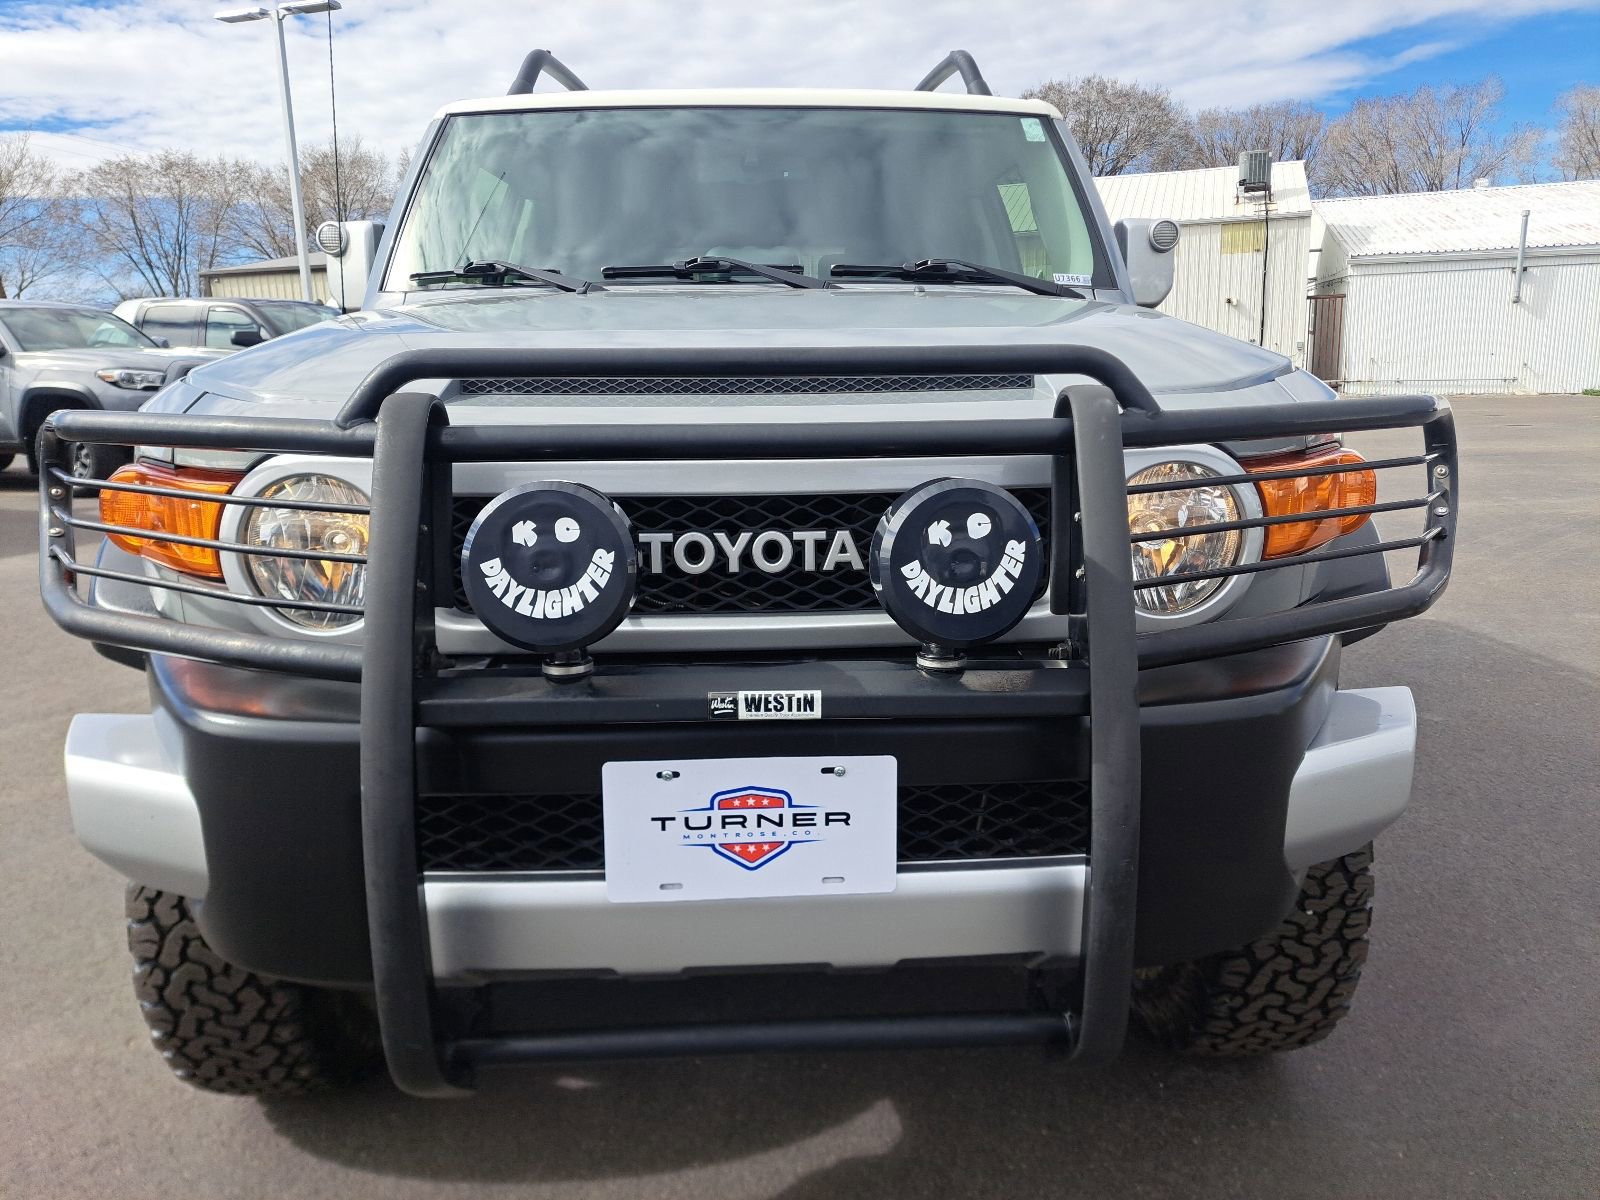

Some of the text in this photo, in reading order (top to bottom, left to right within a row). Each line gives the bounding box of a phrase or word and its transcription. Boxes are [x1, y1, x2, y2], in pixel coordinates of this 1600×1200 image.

[638, 530, 865, 575] TOYOTA
[900, 539, 1026, 614] DAYLIGHTER
[479, 548, 615, 619] DAYLIGHTER
[650, 811, 852, 832] TURNER
